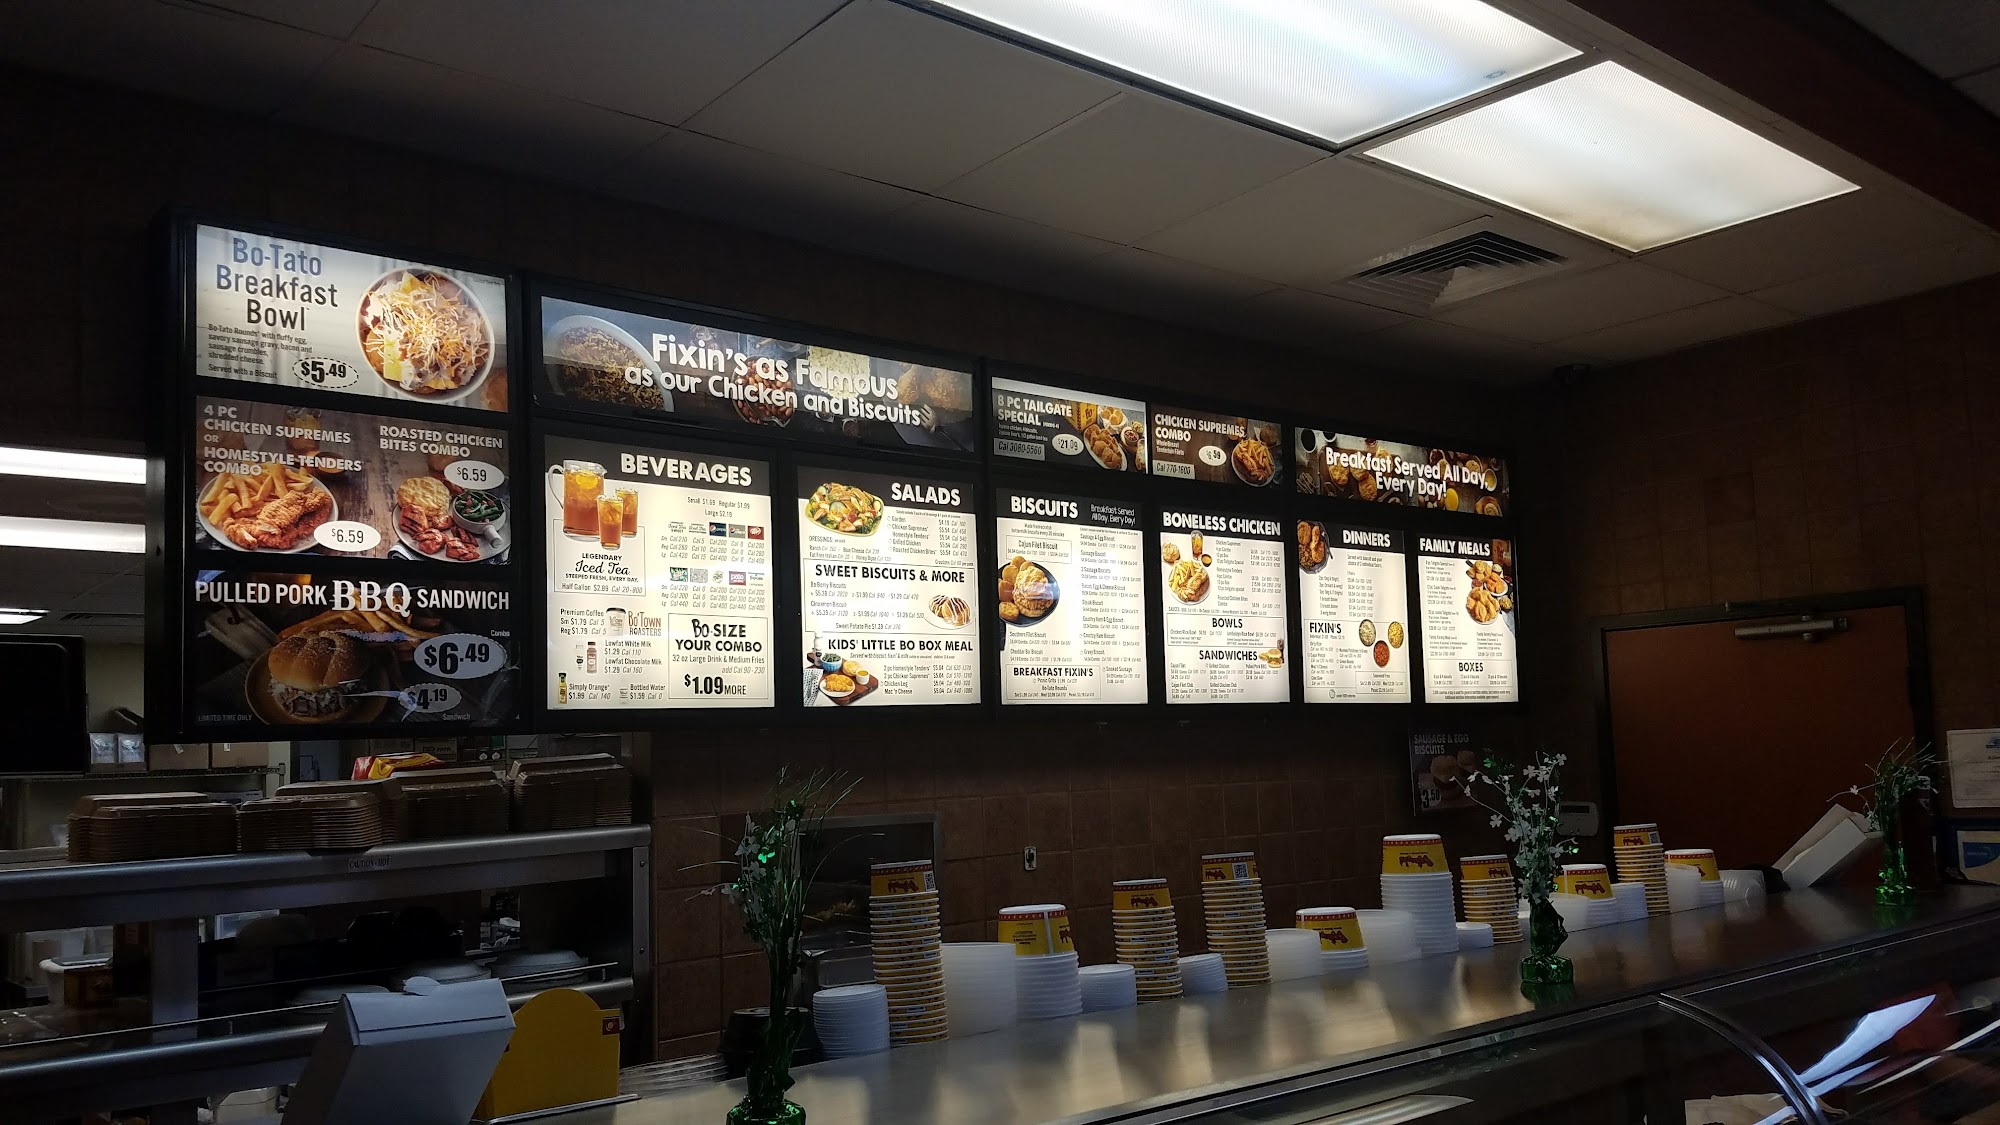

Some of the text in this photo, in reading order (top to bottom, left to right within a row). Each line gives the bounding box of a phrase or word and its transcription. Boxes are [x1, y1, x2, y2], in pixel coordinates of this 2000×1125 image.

[233, 237, 322, 276] Bo-Tato
[216, 264, 338, 307] Breakfast
[247, 299, 305, 331] Bowl
[208, 324, 233, 334] Bo-Tato
[277, 334, 293, 342] fluffy
[295, 337, 308, 345] egg,
[208, 334, 230, 343] savory
[232, 337, 259, 347] sausage
[260, 341, 279, 350] gravy,
[281, 344, 299, 352] bacon
[208, 344, 269, 356] sausage crumbles,
[208, 352, 264, 364] shredded cheese.
[208, 364, 231, 373] Served
[255, 370, 277, 379] Biscuit
[301, 361, 347, 383] $5.49
[652, 332, 899, 400] Fixin's as Famous
[624, 366, 922, 427] as our Chicken and Biscuits
[204, 405, 237, 418] 4 PC
[998, 395, 1004, 407] 8
[1007, 397, 1020, 409] PC
[1023, 399, 1072, 417] TAILGATE
[998, 409, 1041, 426] SPECIAL
[204, 419, 351, 443] CHICKEN SUPREMES
[1155, 414, 1245, 438] CHICKEN SUPREMES
[204, 434, 219, 443] OR
[380, 426, 503, 448] ROASTED CHICKEN
[1155, 427, 1191, 442] COMBO
[380, 439, 471, 457] BITES COMBO
[999, 441, 1009, 450] Cal
[1058, 438, 1078, 450] $21.09
[204, 447, 362, 471] HOMESTYLE TENDERS
[204, 461, 262, 476] COMBO
[457, 467, 487, 482] $6.59
[621, 453, 752, 487] BEVERAGES
[1157, 463, 1165, 471] Cal
[1326, 447, 1489, 490] Breakfast Served All Day,
[891, 482, 961, 506] SALADS
[1376, 472, 1447, 501] Every Day!
[1011, 495, 1078, 519] BISCUITS
[1090, 504, 1135, 516] Breakfast Served
[1110, 515, 1124, 525] Every
[1125, 517, 1136, 526] Day!
[1163, 511, 1281, 536] BONELESS CHICKEN
[331, 528, 364, 543] $6.59
[1342, 529, 1391, 548] DINNERS
[1018, 540, 1058, 550] Cajun Filet Biscuit
[1419, 538, 1490, 556] FAMILY MEALS
[582, 553, 622, 561] LEGENDARY
[575, 560, 629, 575] Iced Tea
[815, 564, 965, 583] SWEET BISCUITS & MORE
[195, 580, 510, 617] PULLED PORK BBQ SANDWICH
[561, 608, 604, 617] Premium Coffee
[571, 618, 587, 626] $1.79
[1212, 618, 1243, 628] BOWLS
[1309, 622, 1342, 634] FIXIN'S
[561, 627, 571, 635] Reg
[629, 628, 661, 636] ROASTERS
[675, 639, 762, 652] YOUR COMBO
[828, 639, 973, 651] KIDS' LITTLE BO BOX MEAL
[424, 642, 490, 675] $6.49
[672, 654, 680, 662] 32
[689, 655, 706, 664] Large
[707, 655, 722, 663] Drink
[728, 656, 751, 664] Medium
[752, 656, 765, 664] Fries
[1199, 650, 1258, 661] SANDWICHES
[604, 666, 620, 674] $1.29
[1013, 667, 1094, 677] BREAKFAST FIXIN'S
[1458, 662, 1483, 672] BOXES
[684, 674, 747, 695] $1.09 MORE
[407, 689, 448, 710] $4.19
[1414, 734, 1446, 744] SAUSAGE
[1455, 734, 1469, 743] EGG
[1415, 745, 1445, 754] BISCUITS
